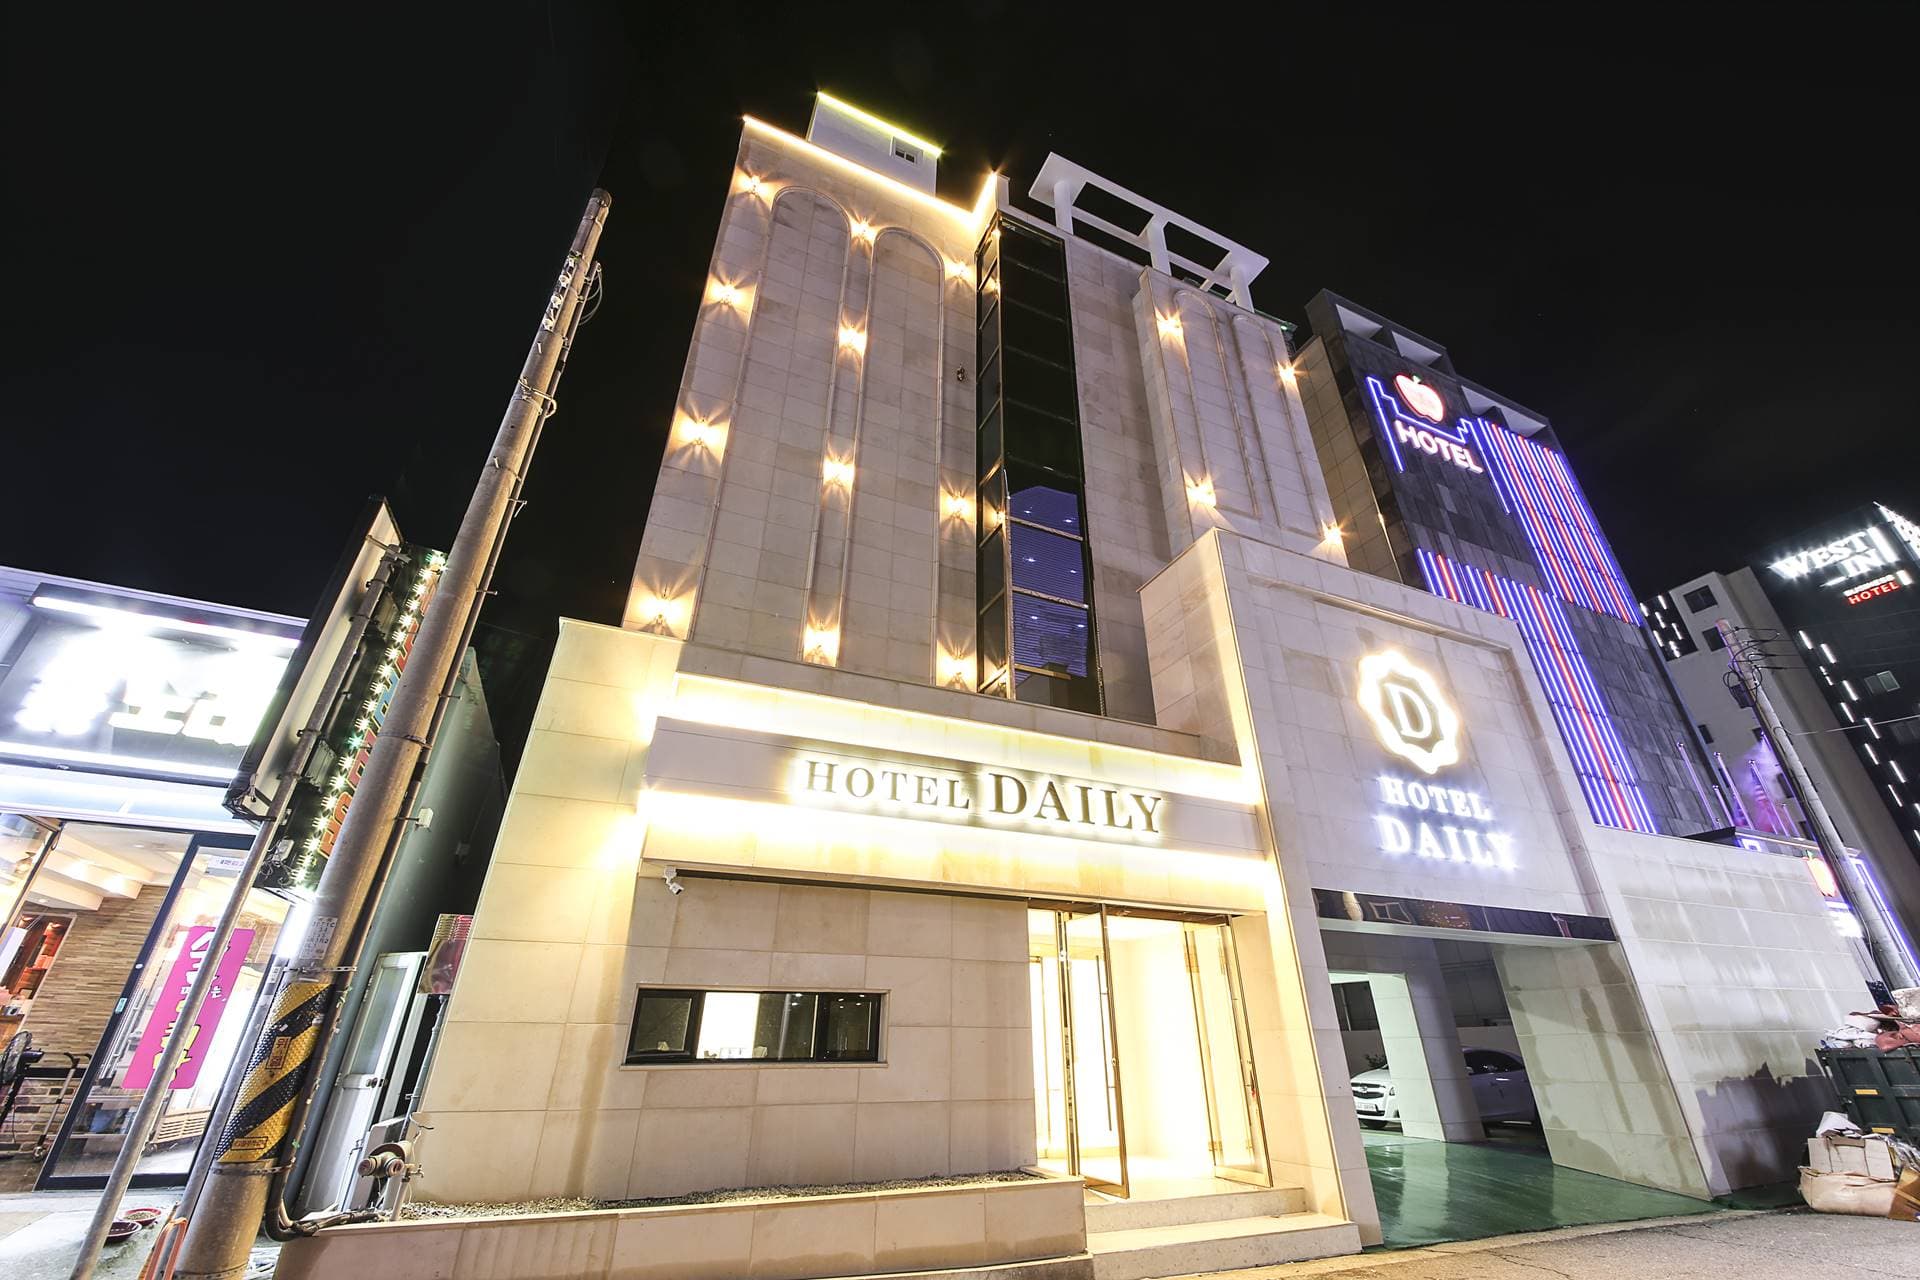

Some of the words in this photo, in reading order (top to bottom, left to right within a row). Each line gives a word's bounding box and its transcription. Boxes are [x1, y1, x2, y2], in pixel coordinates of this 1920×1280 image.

[1394, 419, 1484, 474] HOTEL
[1767, 531, 1869, 579] WEST
[1848, 580, 1900, 605] HOTEL
[1382, 682, 1432, 739] D
[805, 760, 970, 810] HOTEL
[988, 772, 1162, 834] DAILY
[1377, 775, 1491, 821] HOTEL
[1375, 814, 1517, 870] DAILY
